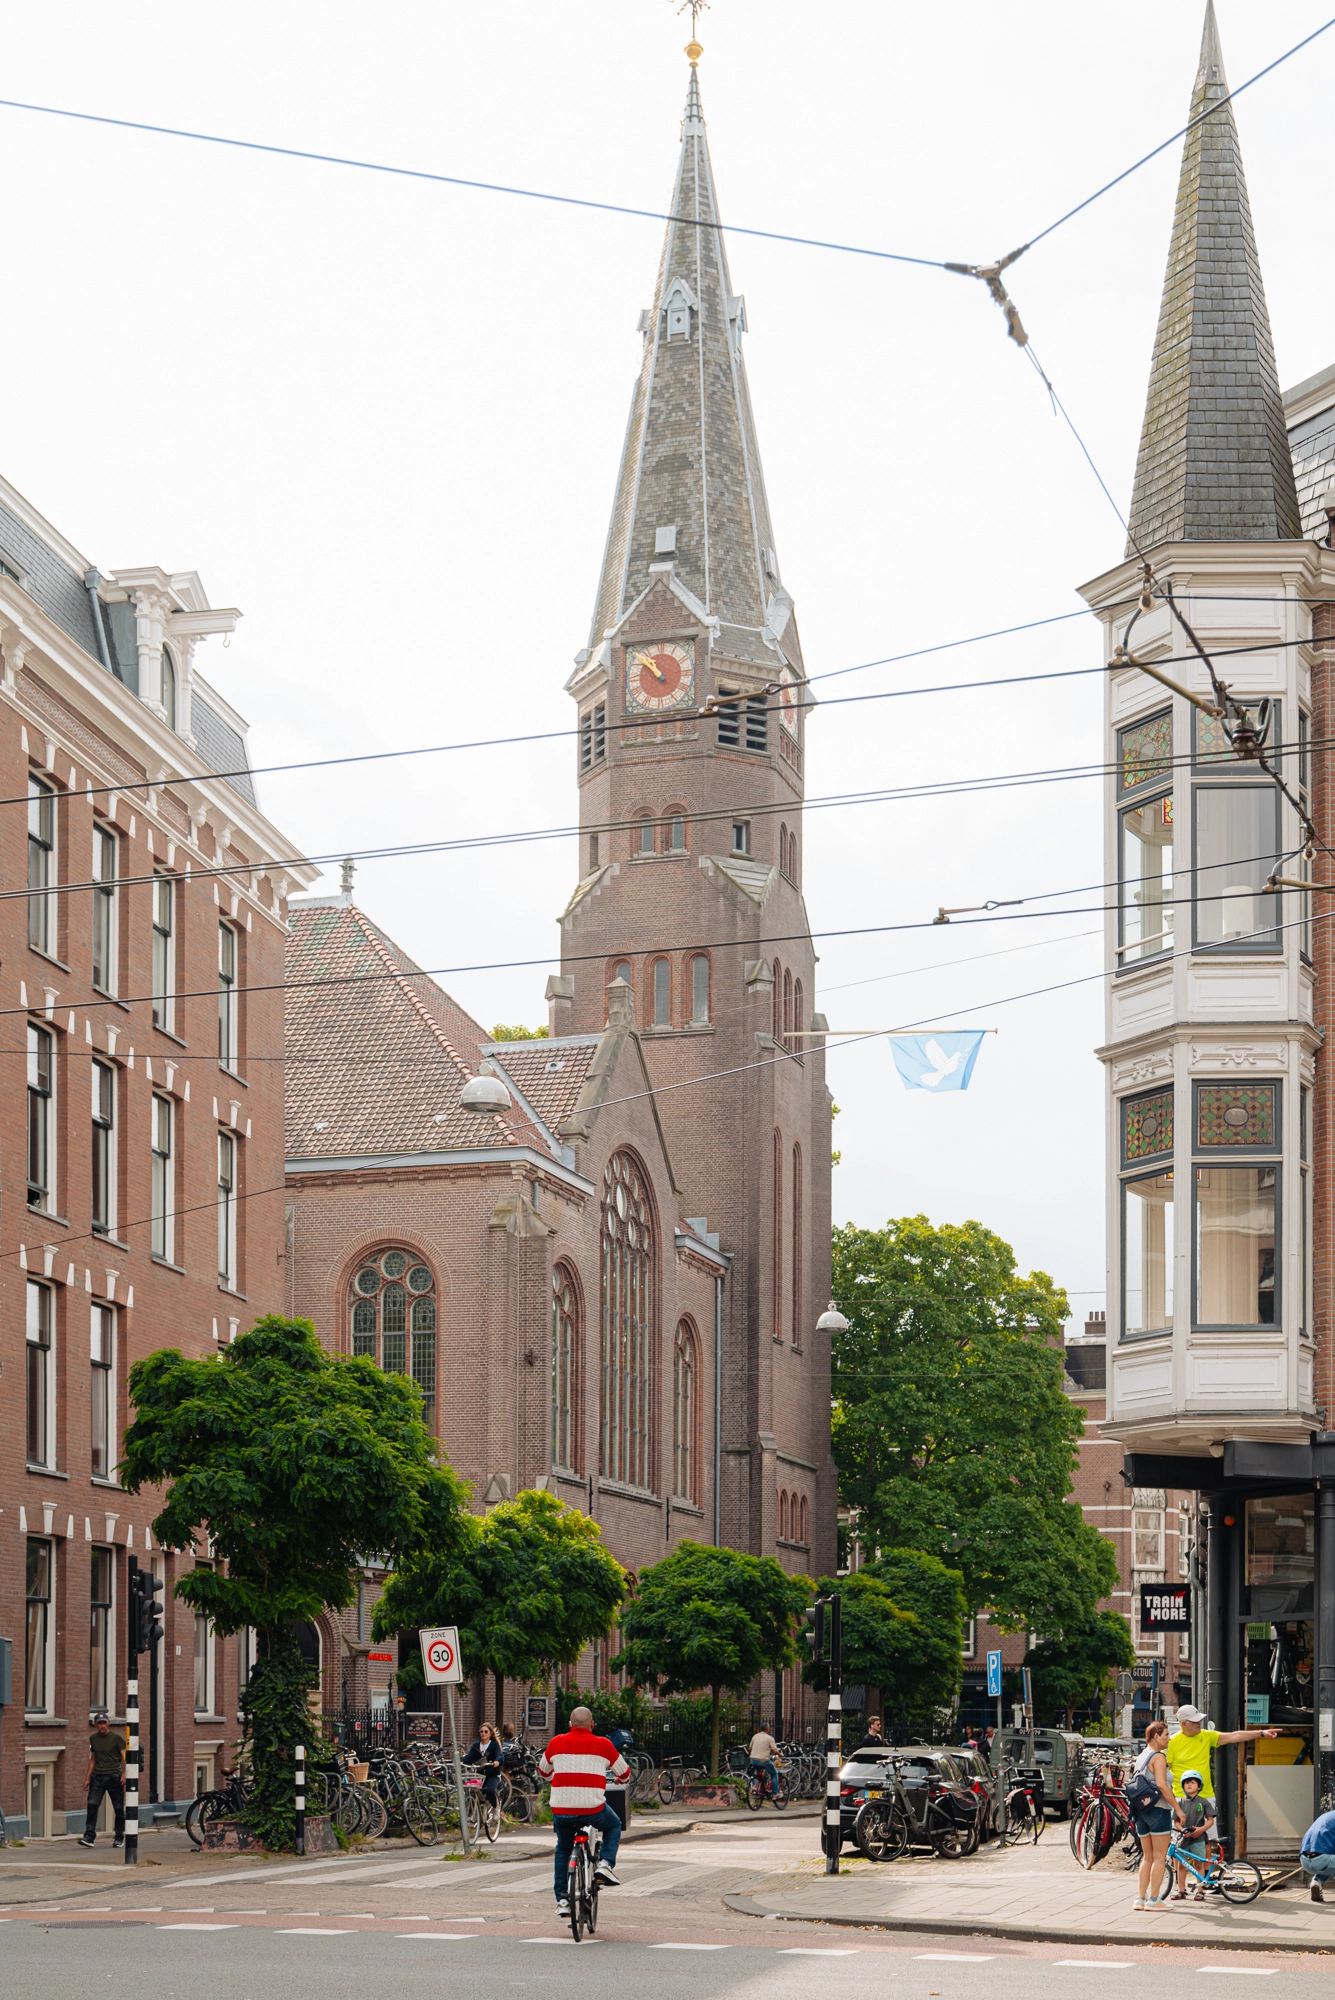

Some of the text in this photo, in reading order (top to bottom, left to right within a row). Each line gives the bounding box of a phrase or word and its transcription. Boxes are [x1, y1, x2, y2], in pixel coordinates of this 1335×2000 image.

[1144, 1595, 1184, 1608] TRAIN
[1150, 1608, 1187, 1620] MORE
[432, 1649, 450, 1663] 30
[989, 1654, 998, 1678] P
